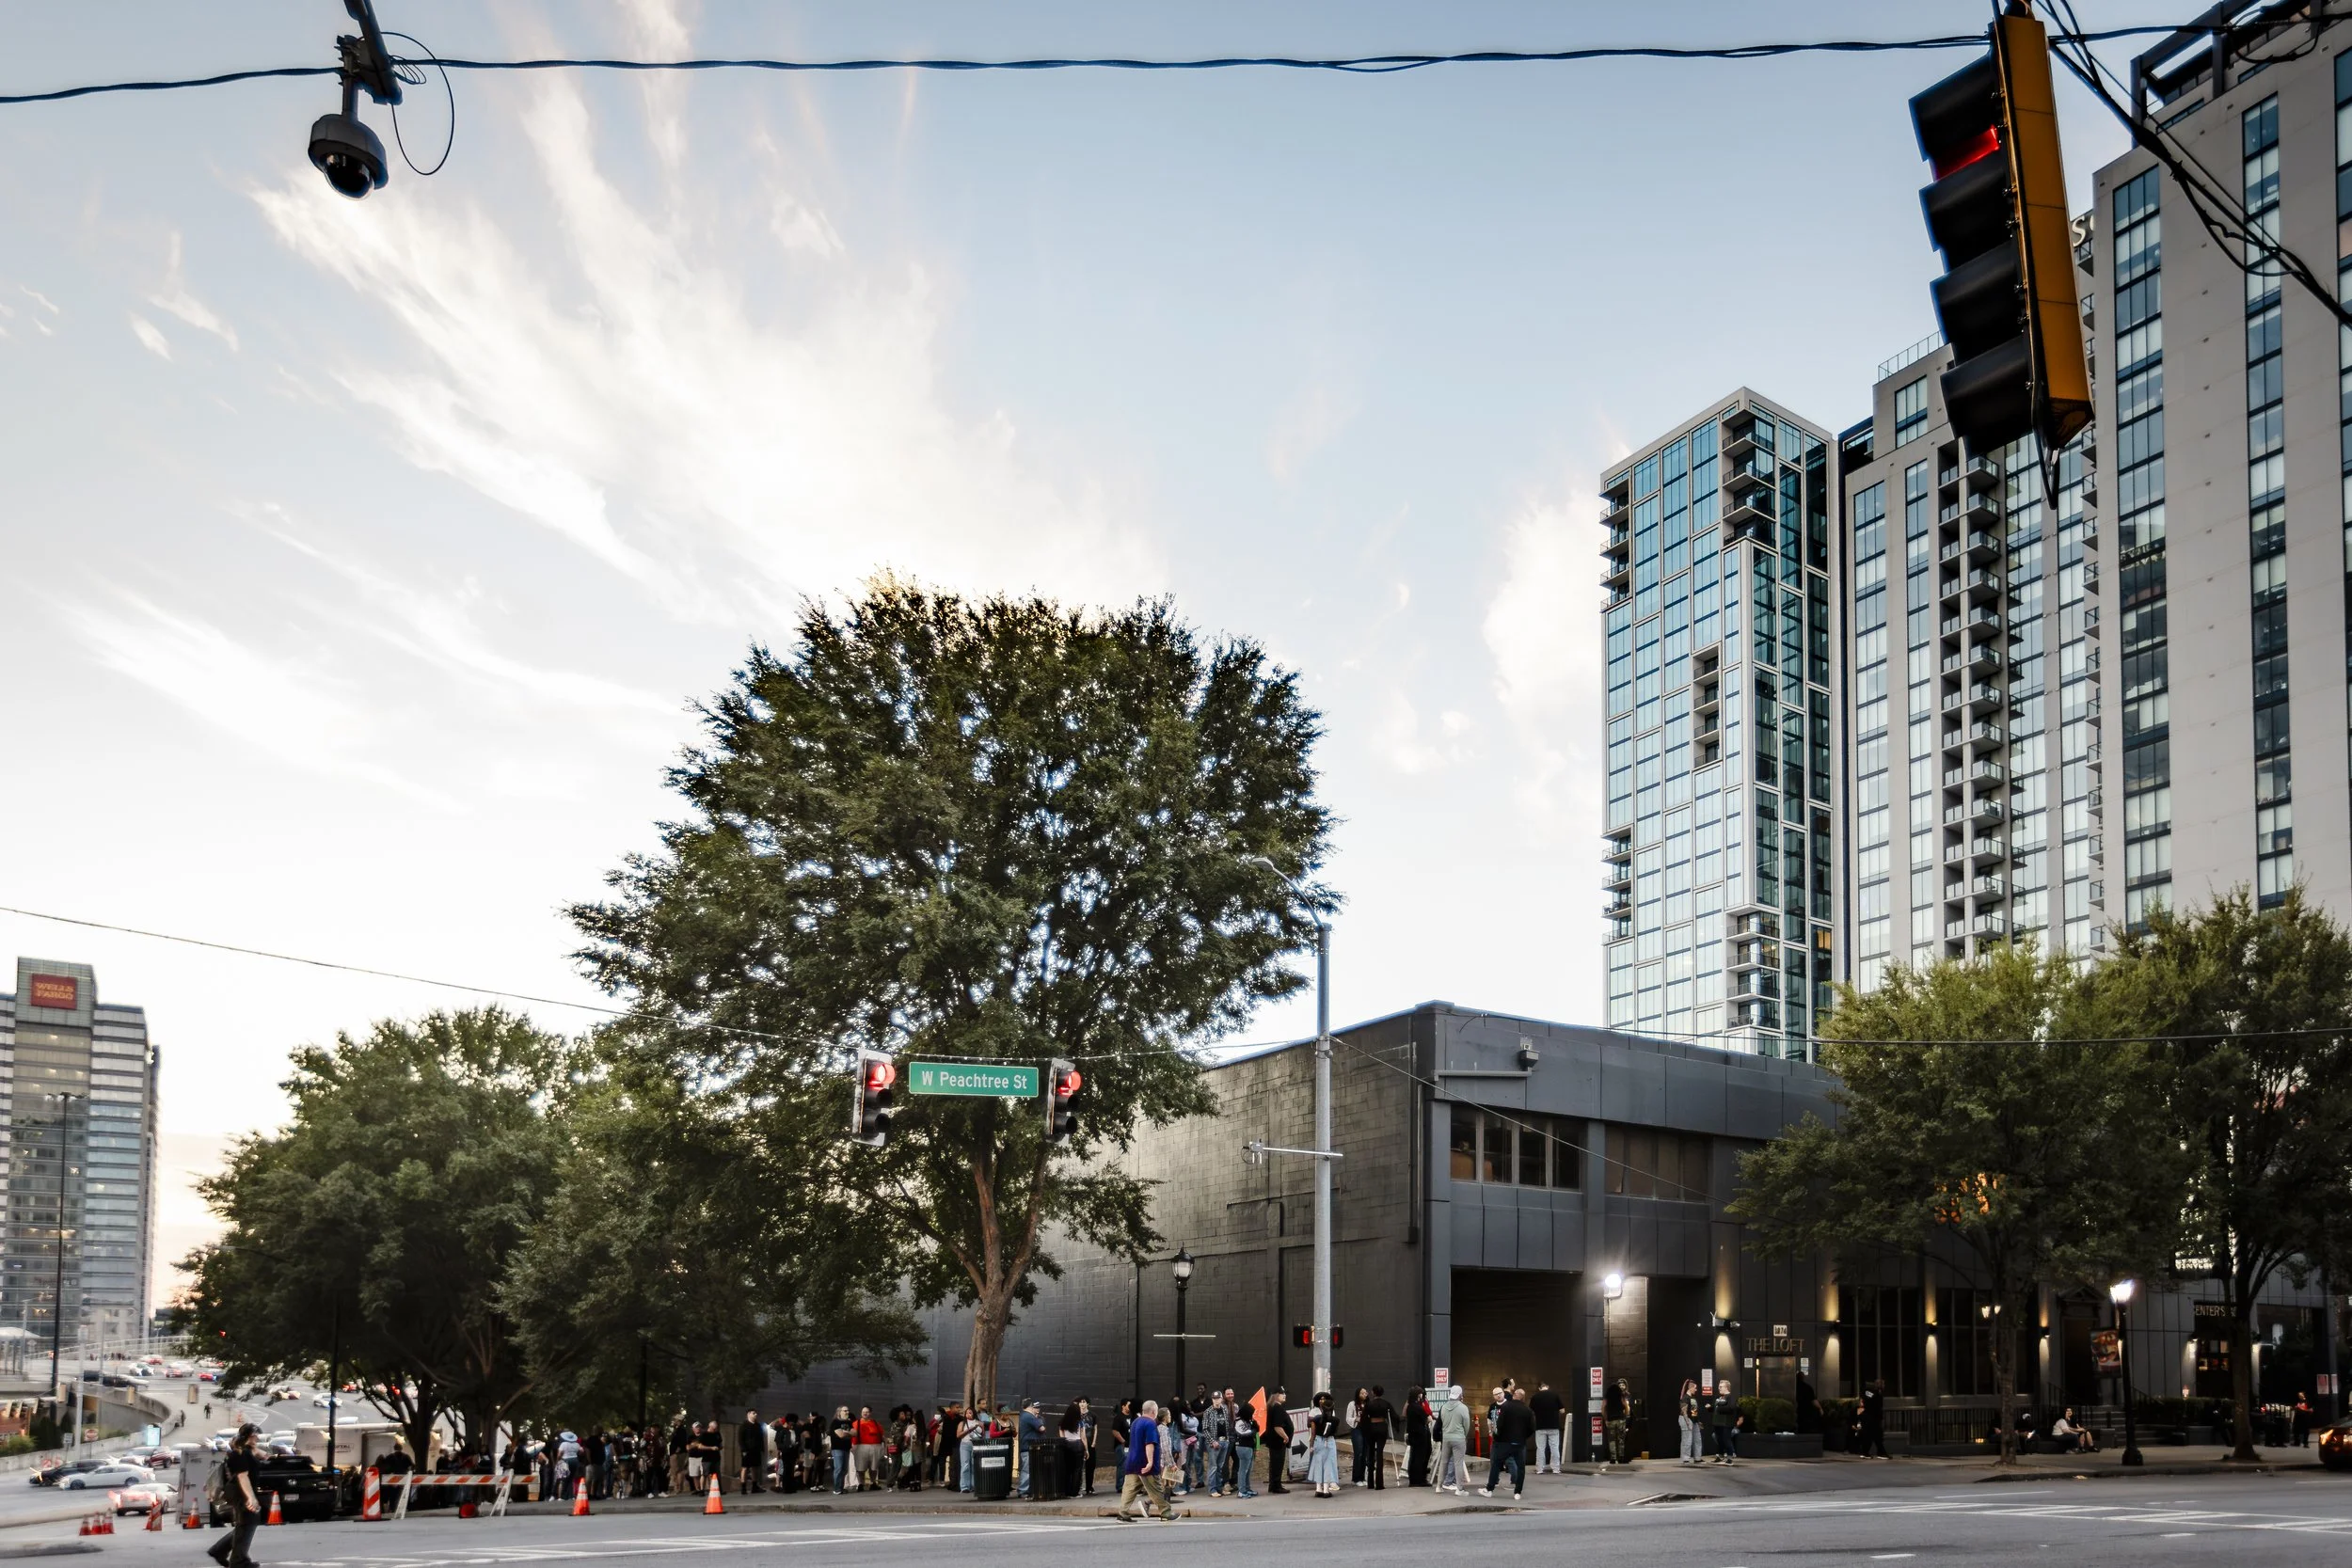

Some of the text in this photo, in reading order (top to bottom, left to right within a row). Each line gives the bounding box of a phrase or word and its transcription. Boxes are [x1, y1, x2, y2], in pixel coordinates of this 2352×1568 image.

[36, 982, 74, 992] WELLS
[36, 990, 73, 1000] FARGO
[922, 1070, 1027, 1089] W Peachtree St
[1746, 1337, 1804, 1353] THE LOFT
